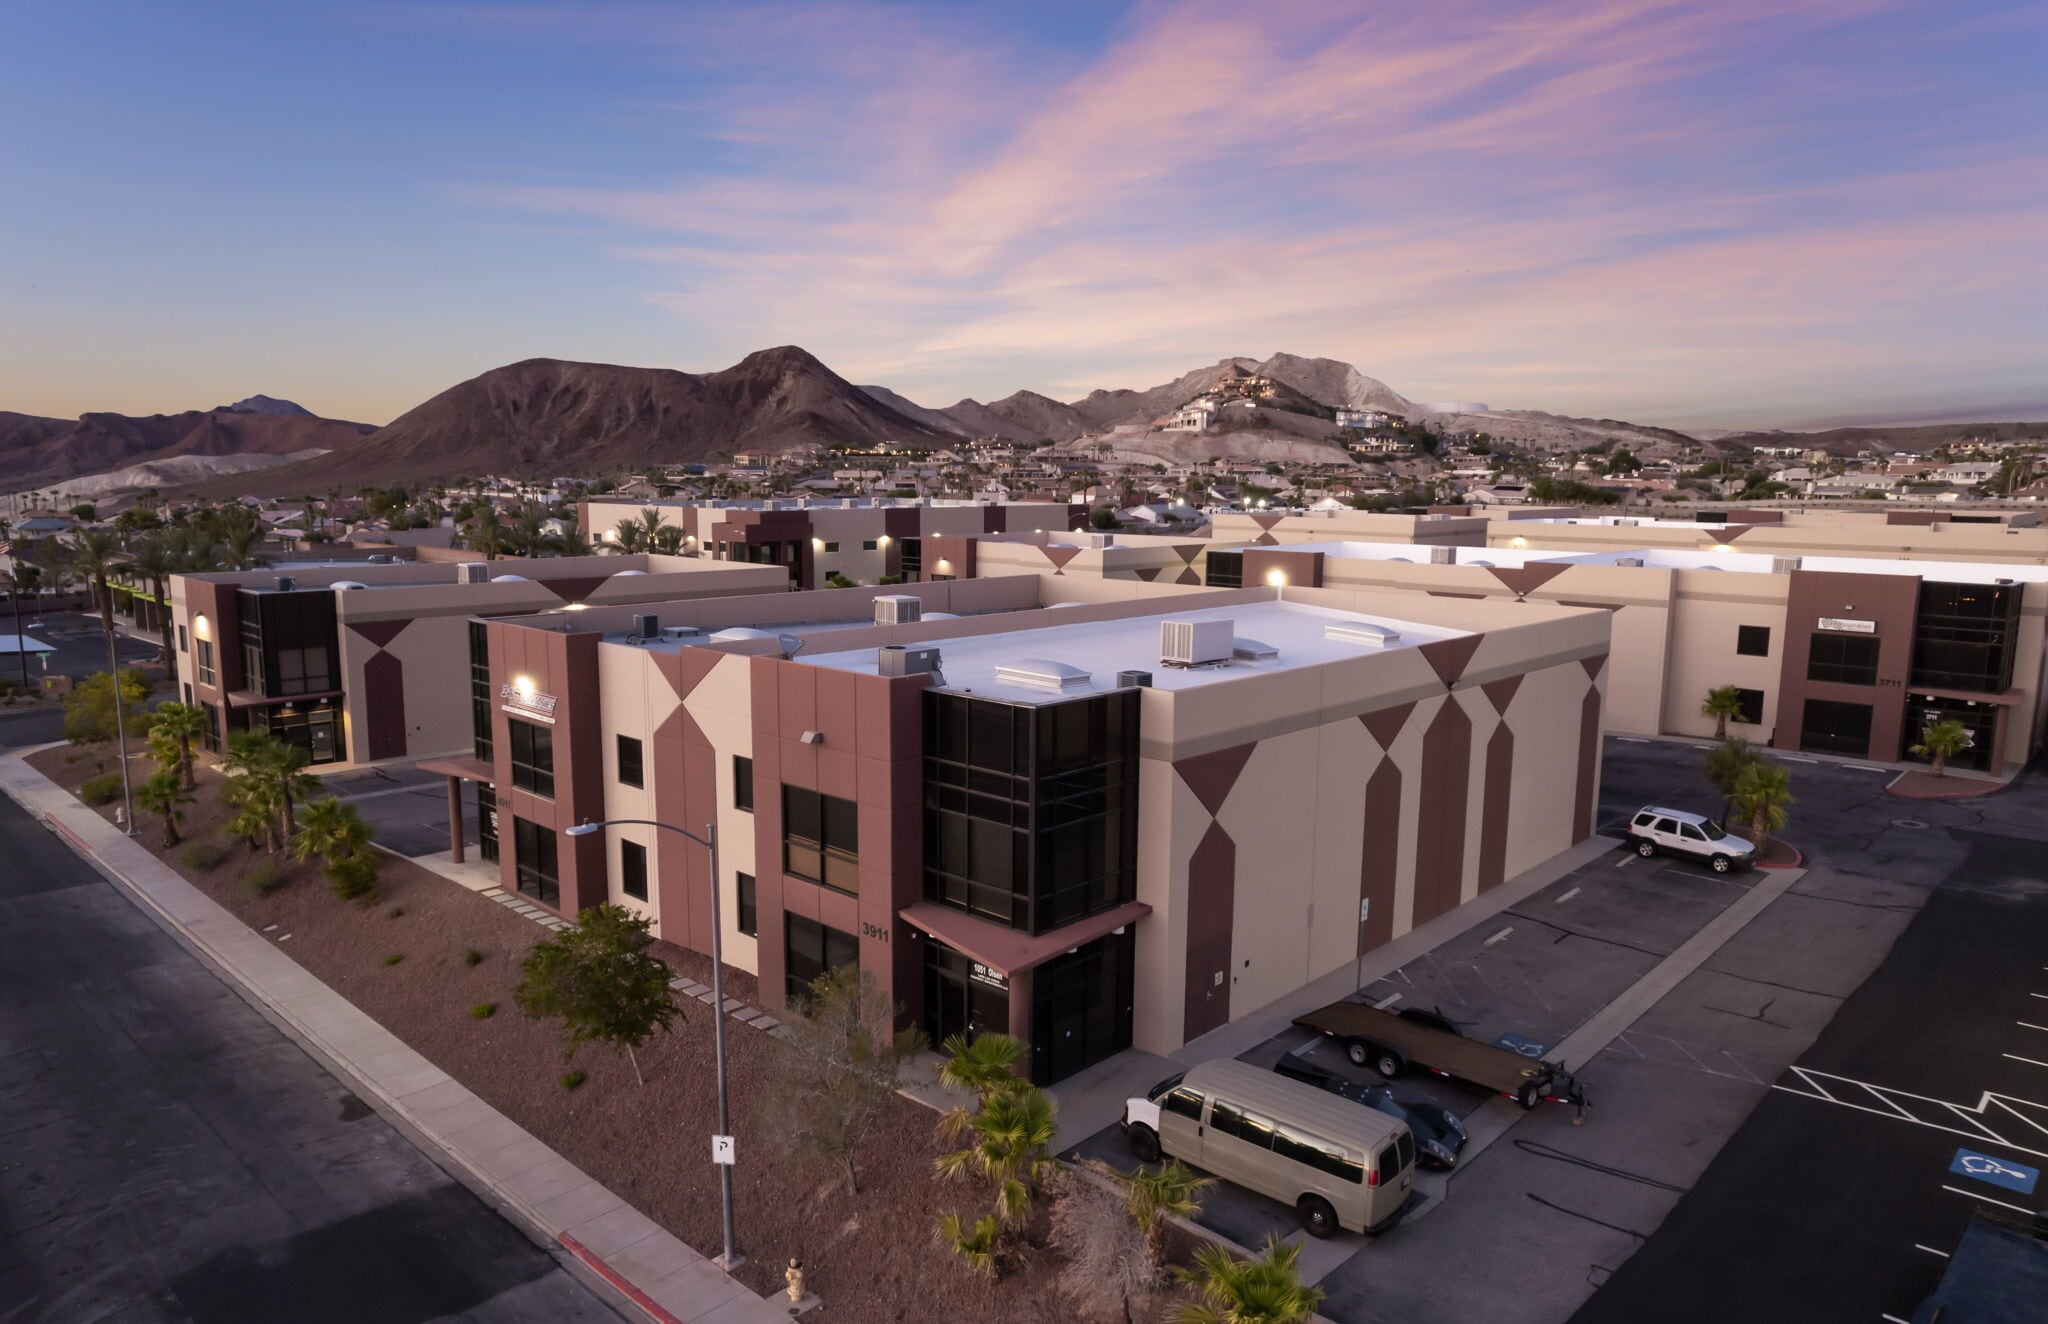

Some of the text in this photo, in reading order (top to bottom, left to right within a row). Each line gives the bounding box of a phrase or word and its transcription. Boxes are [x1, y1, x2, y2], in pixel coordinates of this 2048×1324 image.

[1879, 678, 1902, 688] 3711
[862, 921, 889, 943] 3911
[974, 962, 986, 975] 1051
